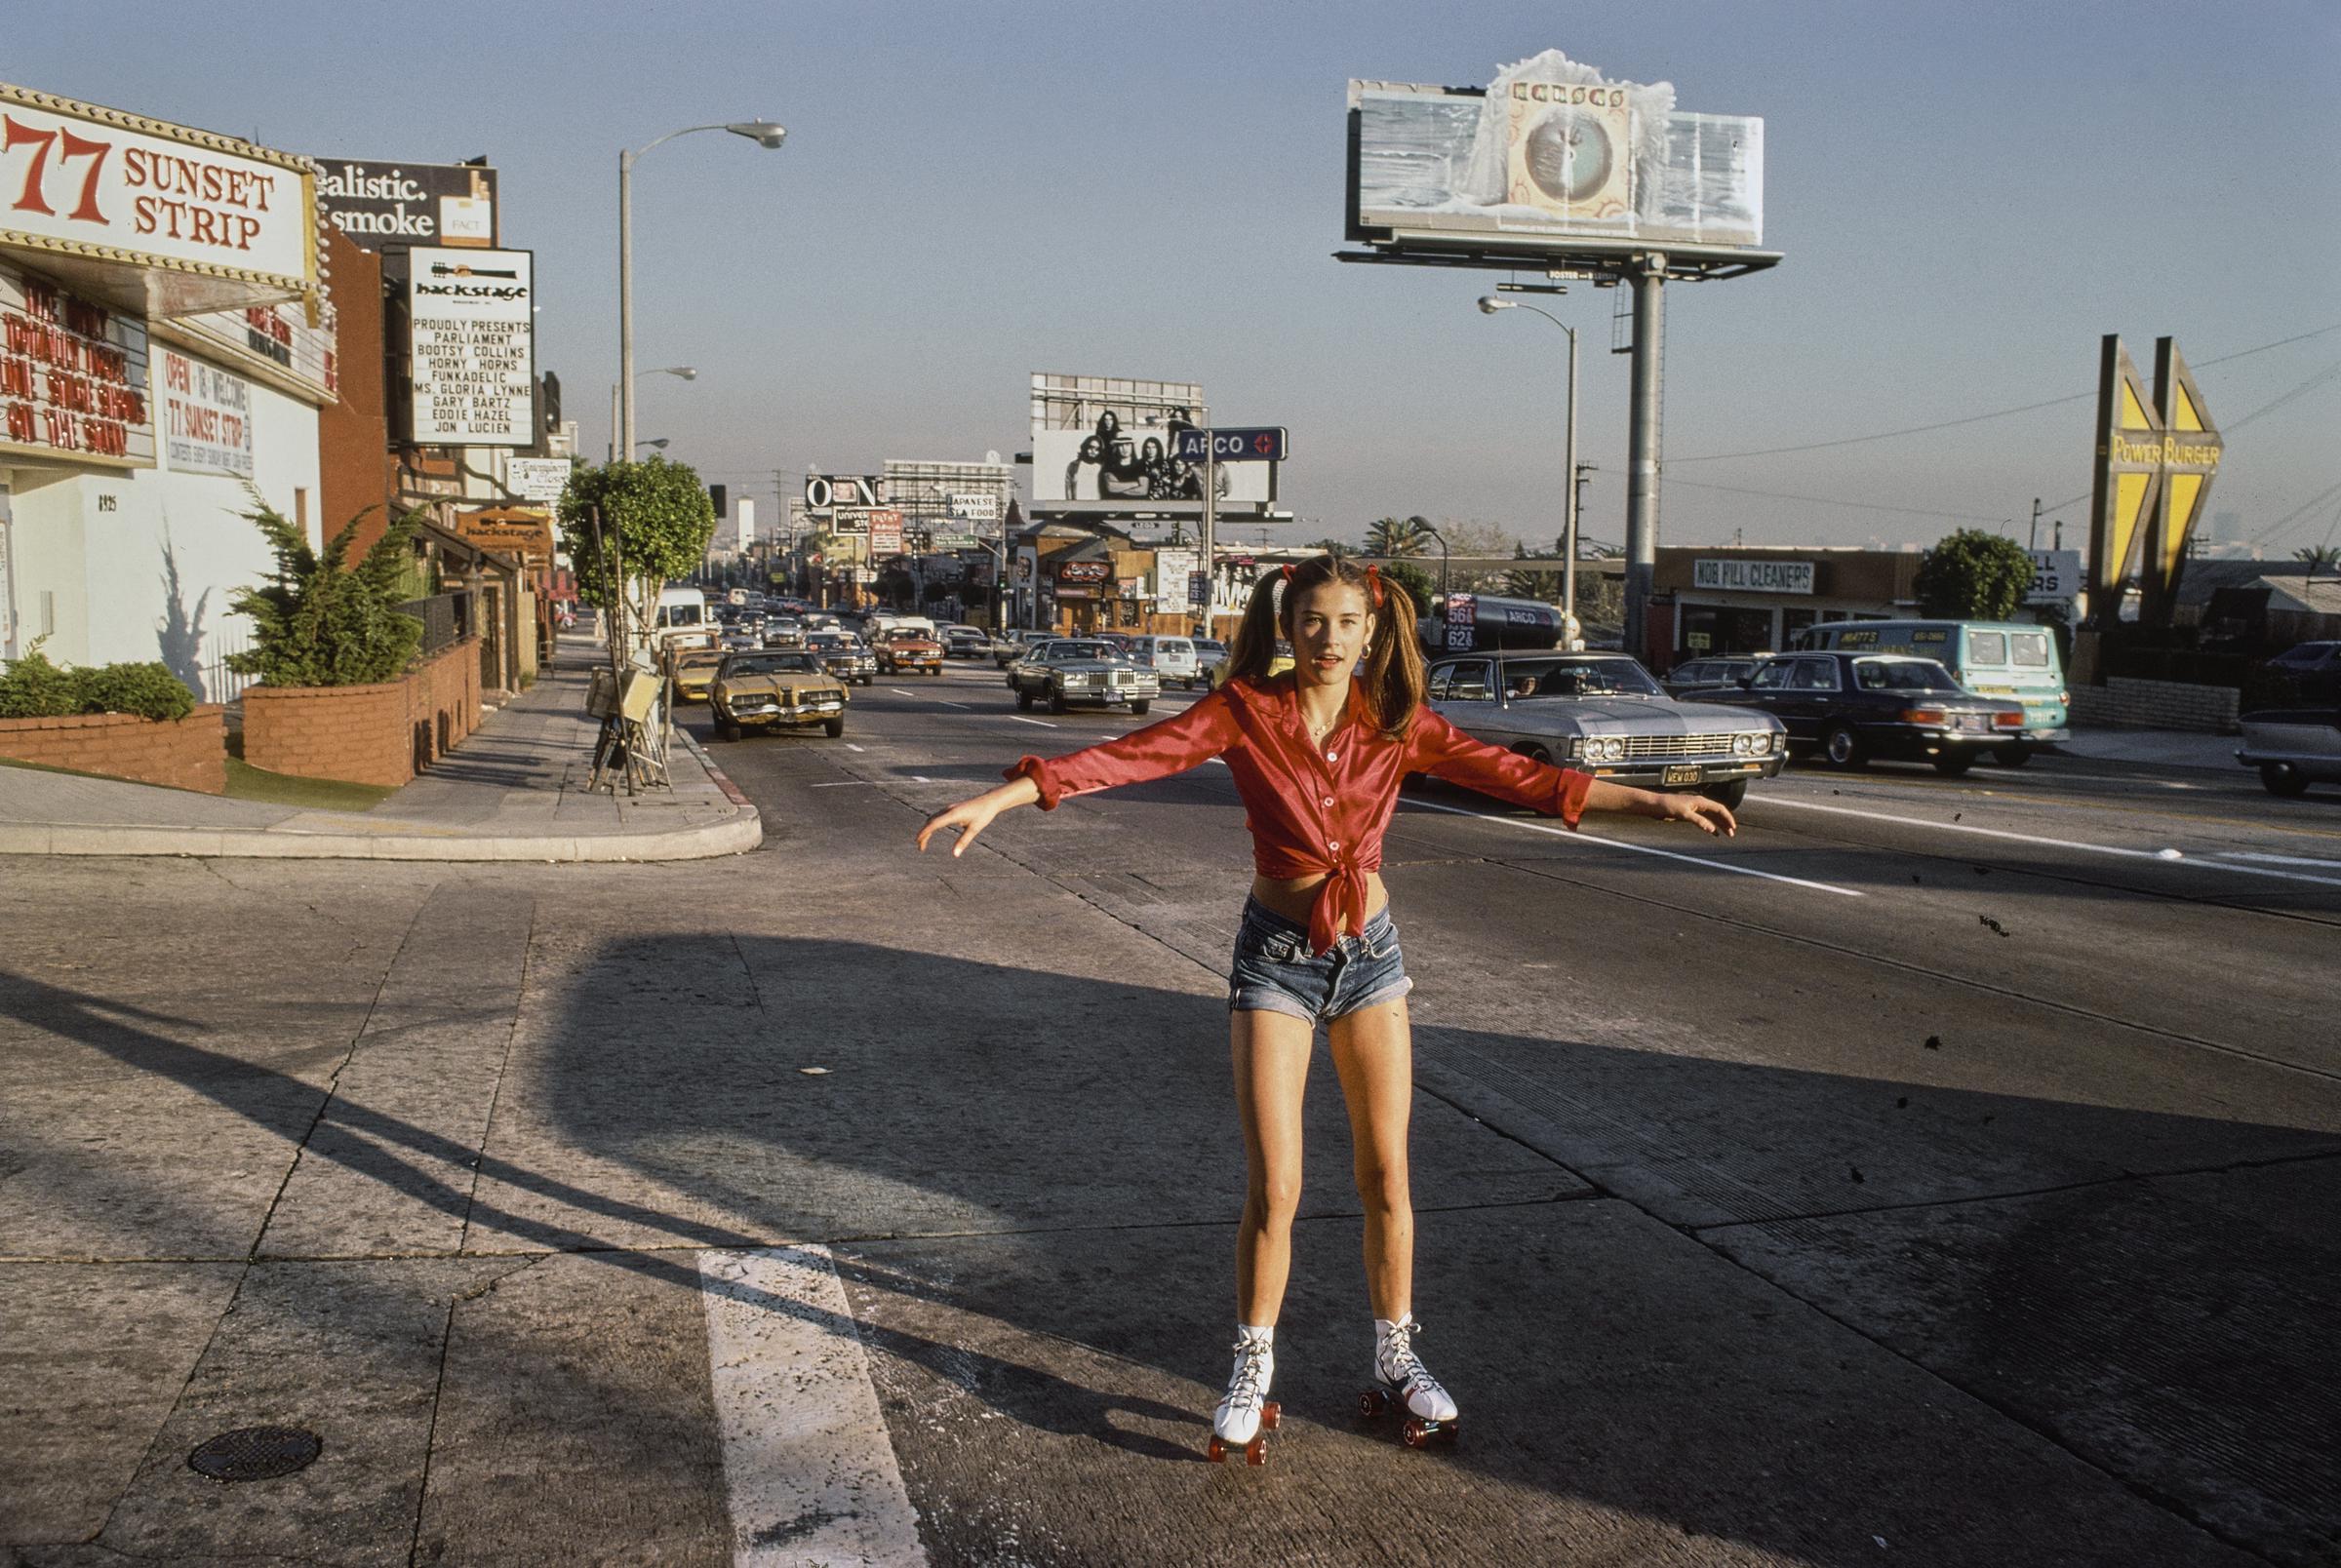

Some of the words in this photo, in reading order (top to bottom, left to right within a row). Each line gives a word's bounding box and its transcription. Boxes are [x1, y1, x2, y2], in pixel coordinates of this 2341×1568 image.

[2, 113, 111, 225] 77
[124, 147, 274, 212] SUNSET
[135, 195, 260, 251] STRIP
[331, 203, 434, 236] smoke
[452, 219, 480, 230] FACT
[1549, 270, 1578, 279] FOSTER
[416, 283, 528, 301] backstage
[414, 319, 467, 332] PROUDLY
[472, 321, 531, 333] PRESENTS
[434, 333, 512, 345] PARLIAMENT
[417, 344, 463, 357] BOOTSY
[474, 346, 525, 359] COLLINS
[429, 358, 467, 370] HORNY
[479, 360, 517, 371] HORNS
[166, 352, 190, 396] OPEN
[432, 371, 506, 383] FUNKADELIC
[415, 383, 436, 395] MS.
[440, 384, 485, 395] GLORIA
[494, 385, 531, 397] LYNNE
[433, 396, 464, 408] GARY
[472, 398, 511, 409] BARTZ
[432, 410, 467, 420] EDDIE
[474, 411, 512, 421] HAZEL
[185, 403, 219, 444] SUNSET
[222, 413, 243, 449] STRIP
[435, 422, 457, 432] JON
[468, 423, 511, 434] LUCIEN
[2113, 435, 2162, 464] POWER
[2162, 436, 2221, 465] BURGER
[948, 496, 993, 506] JAPANESE
[972, 508, 995, 517] FOOD
[465, 527, 543, 541] backstage
[1697, 562, 1719, 585] NOB
[1723, 564, 1744, 586] HILL
[1750, 565, 1810, 589] CLEANERS
[1509, 610, 1536, 624] ARCO
